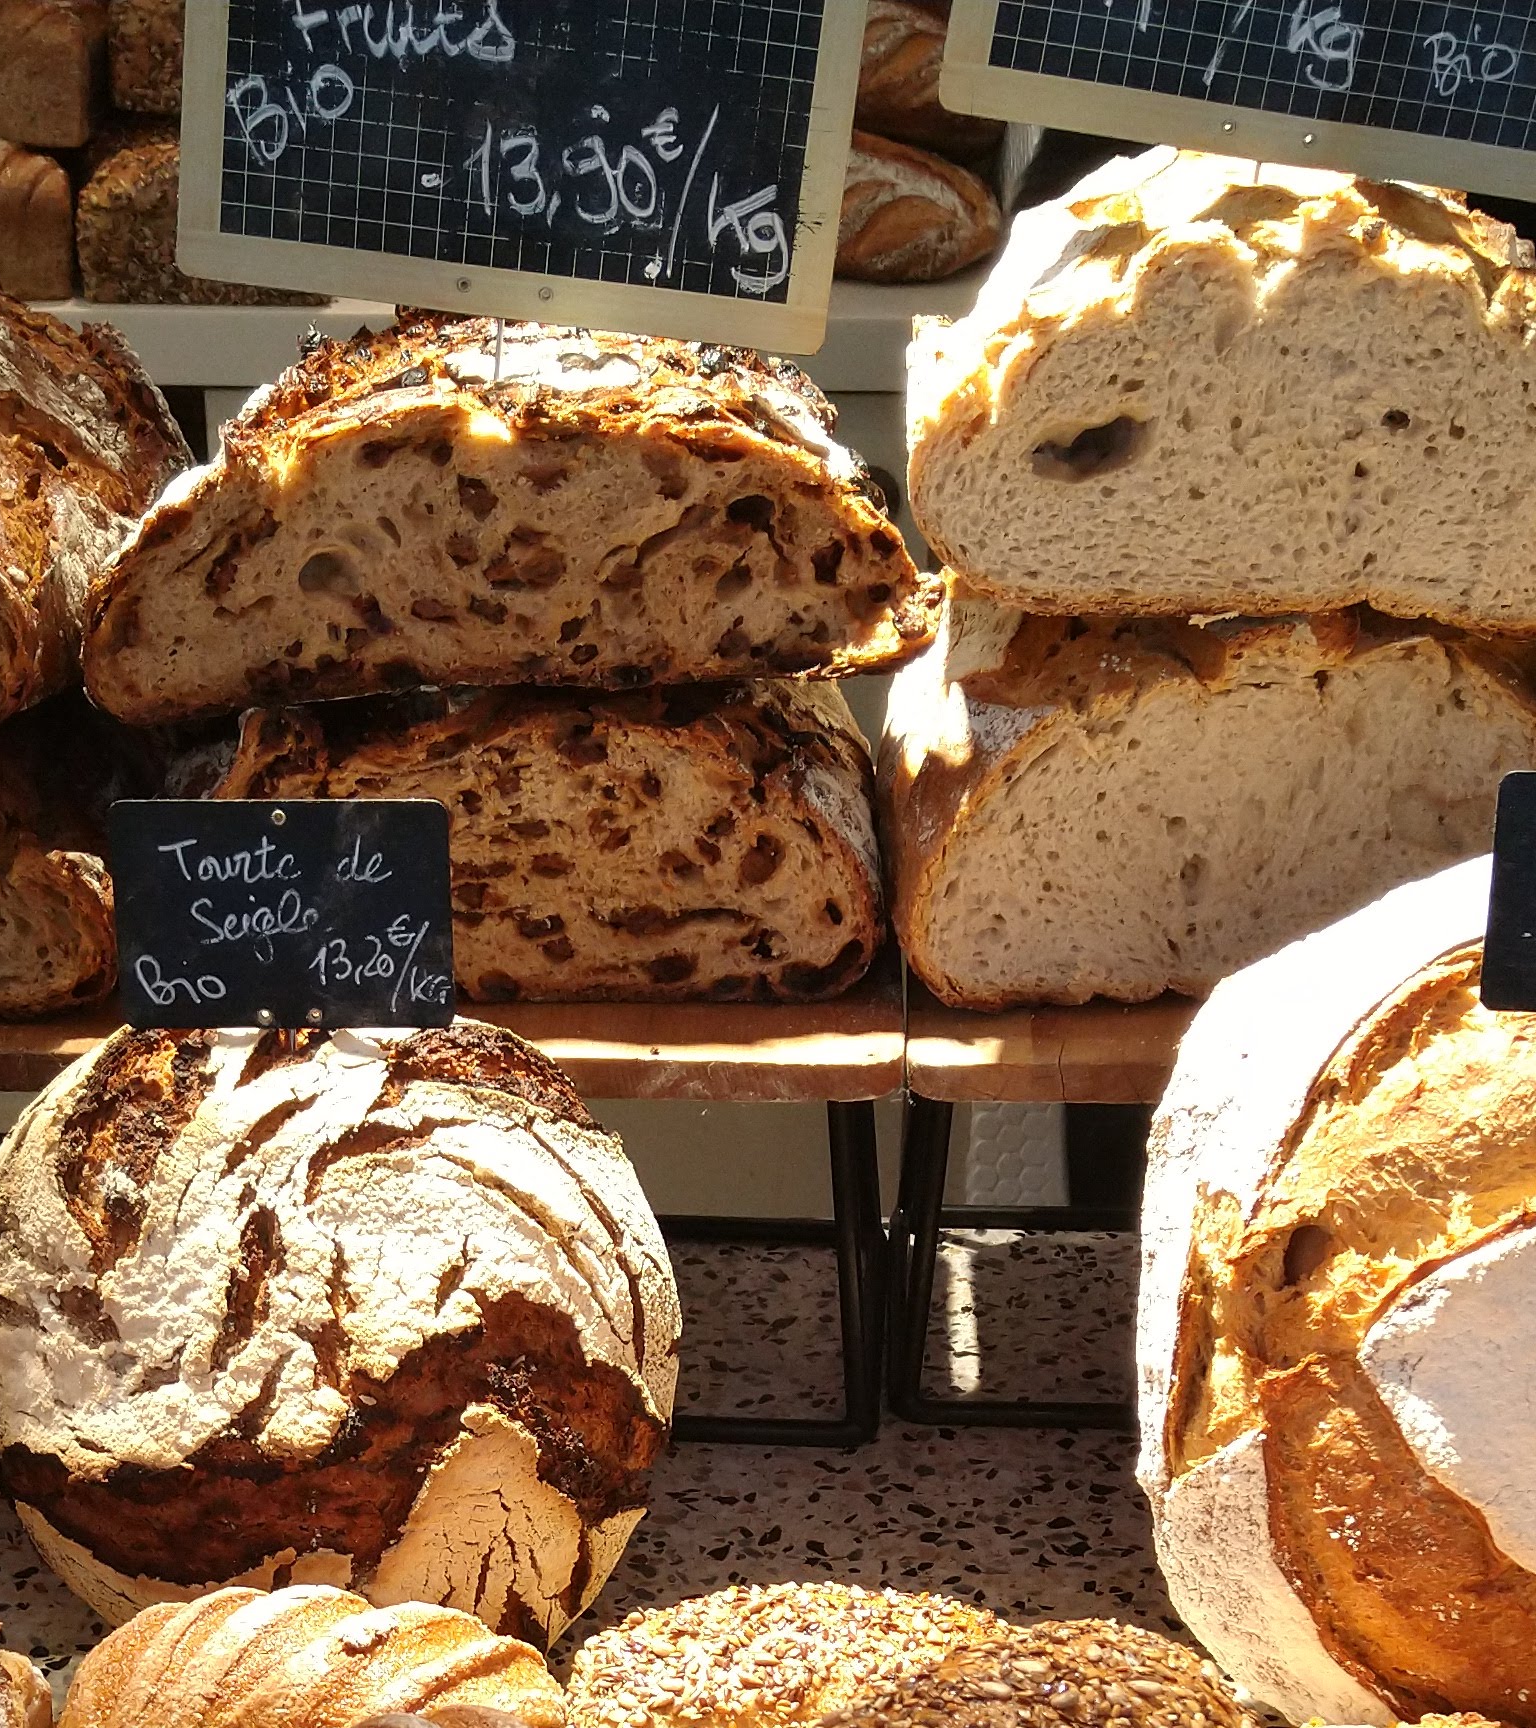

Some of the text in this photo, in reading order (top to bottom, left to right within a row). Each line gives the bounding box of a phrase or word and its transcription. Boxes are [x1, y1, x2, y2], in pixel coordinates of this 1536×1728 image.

[1424, 24, 1518, 97] Bio
[228, 61, 354, 166] Bio
[158, 834, 392, 884] Tourte de
[190, 887, 320, 964] Seigle
[135, 954, 227, 1006] Bio
